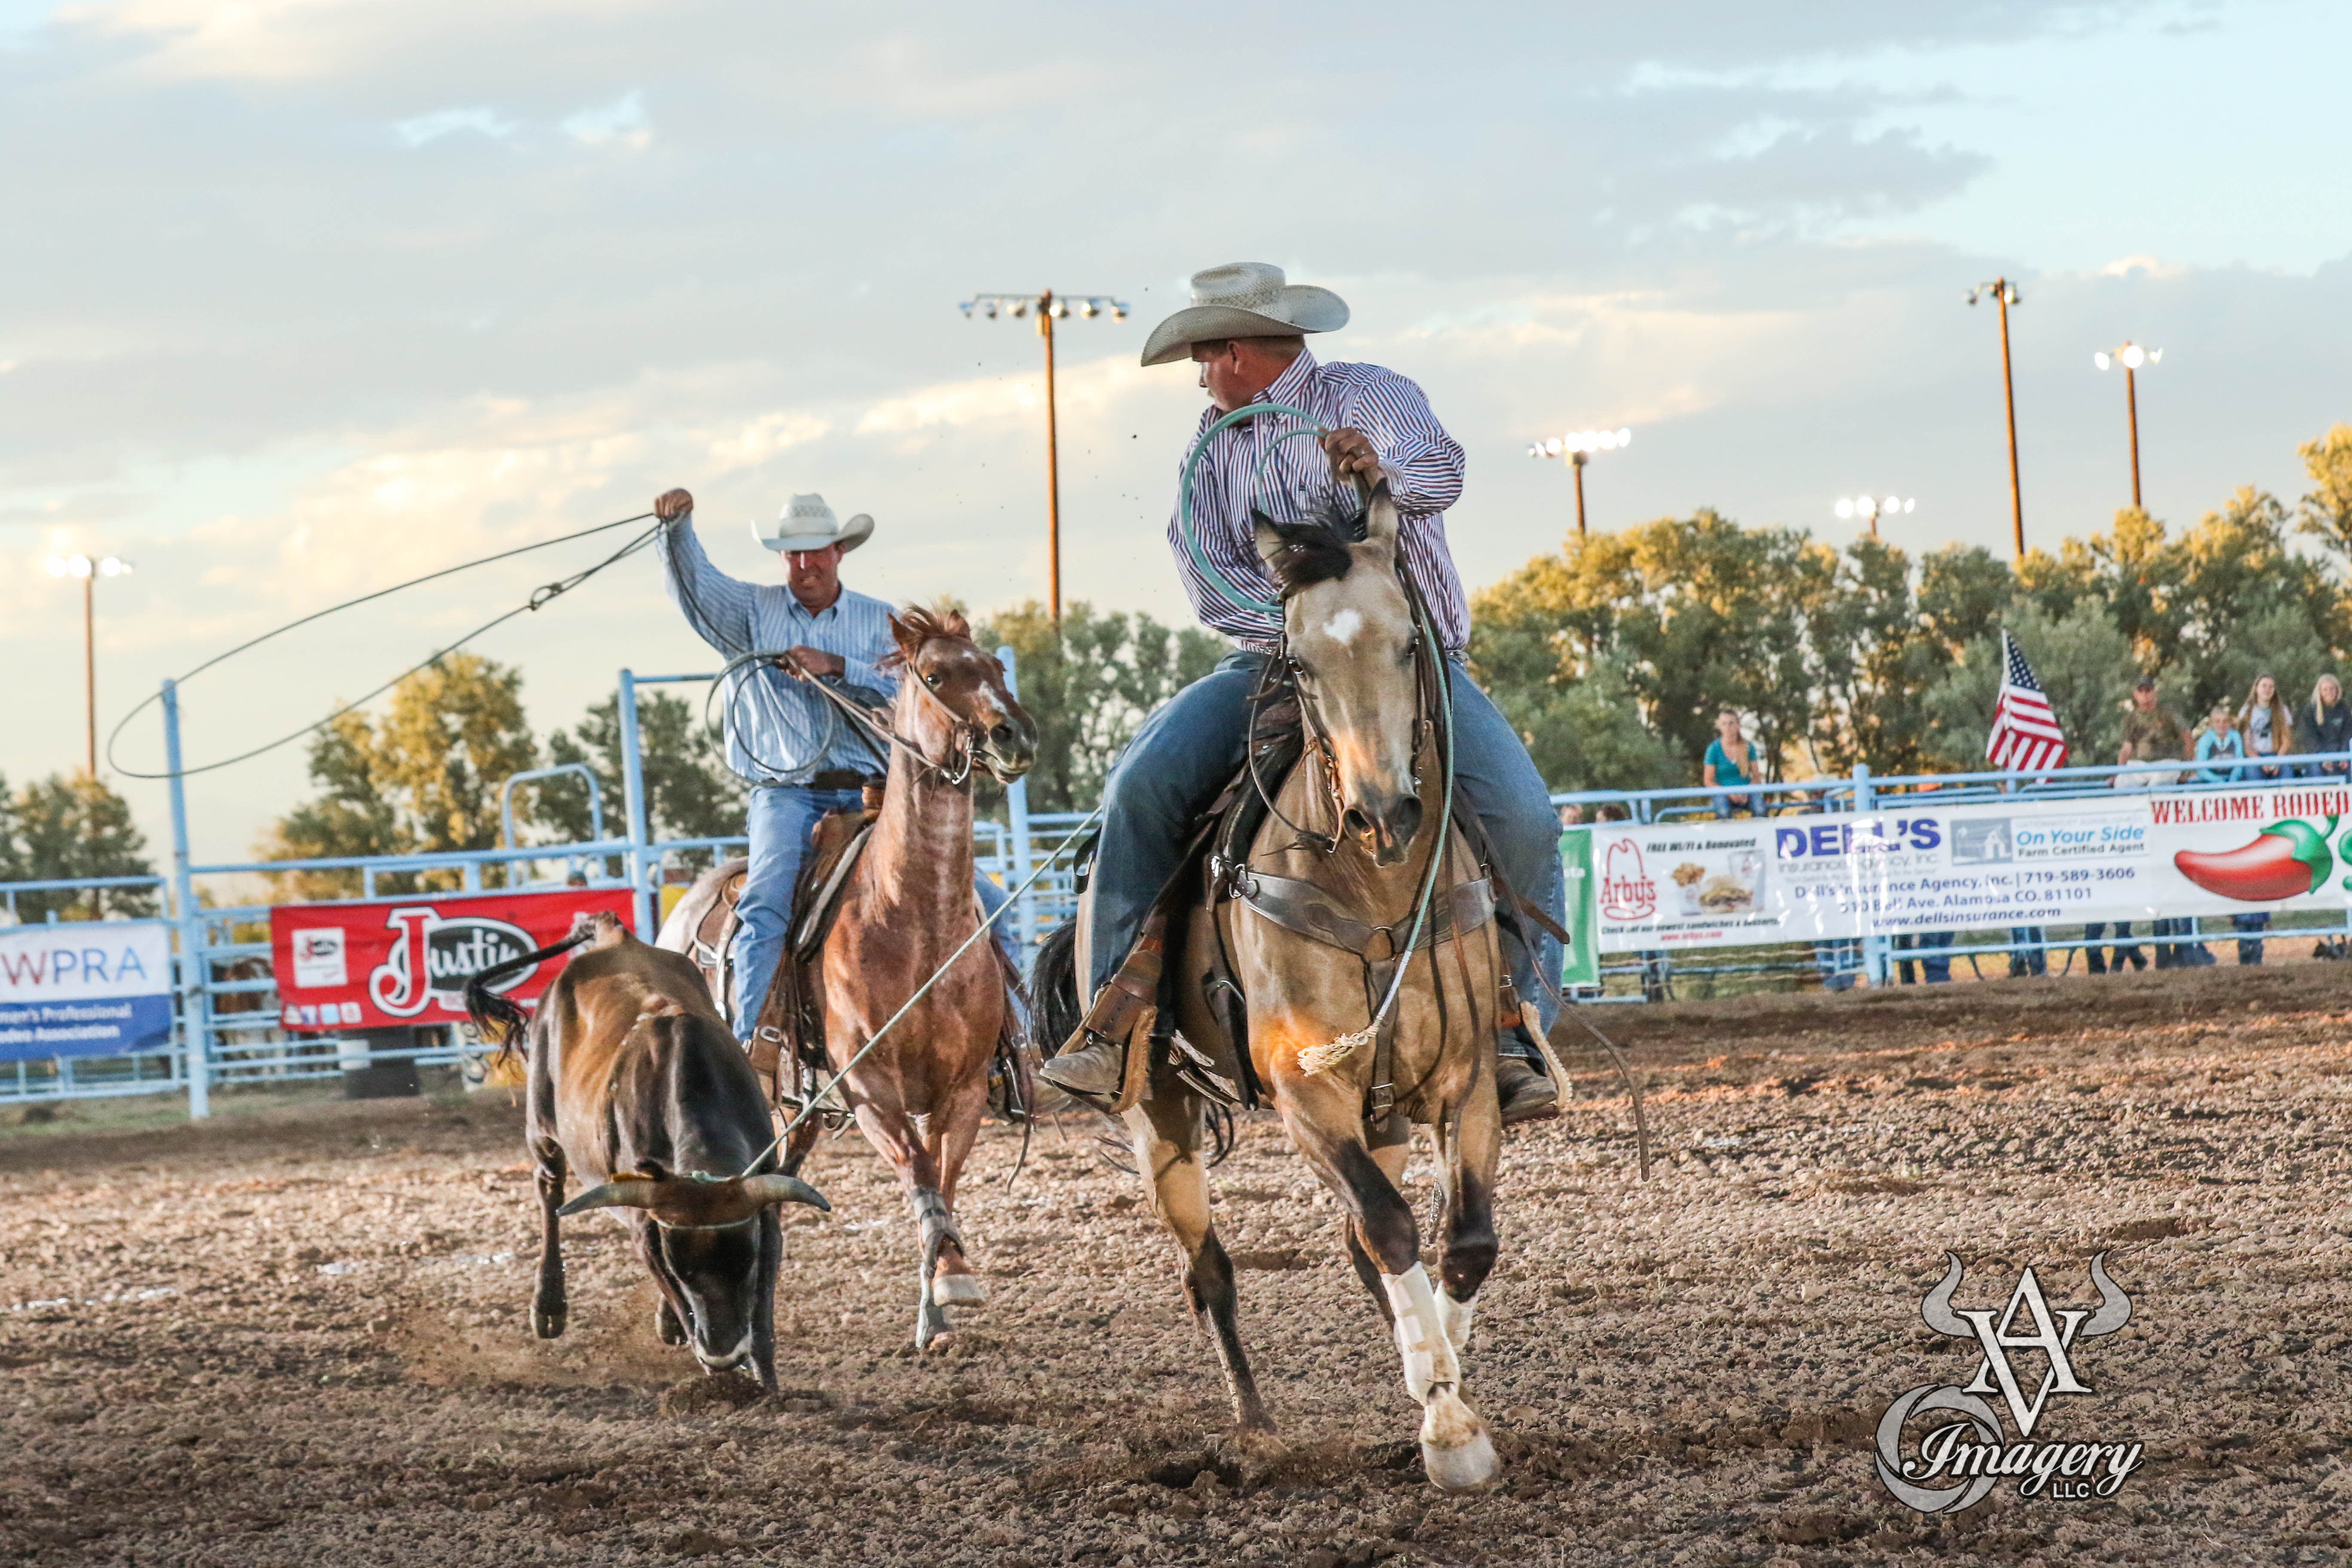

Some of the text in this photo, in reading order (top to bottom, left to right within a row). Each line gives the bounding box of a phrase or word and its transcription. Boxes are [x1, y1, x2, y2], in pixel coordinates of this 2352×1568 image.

[2152, 791, 2349, 824] WELCOME RODEO
[1775, 819, 1941, 859] DELL'S
[2017, 830, 2045, 846] On
[2051, 828, 2095, 844] Your
[2018, 842, 2145, 858] Farm Certified Agent
[1600, 875, 1656, 908] Arby's
[1795, 885, 1835, 899] Dll's
[2025, 866, 2135, 884] 719-589-3606
[1907, 897, 1939, 909] Ave.
[2044, 886, 2092, 901] 81101
[1872, 907, 2061, 927] www.dellsinsurance.com
[1, 946, 147, 985] WPRA
[372, 909, 520, 1014] Justin
